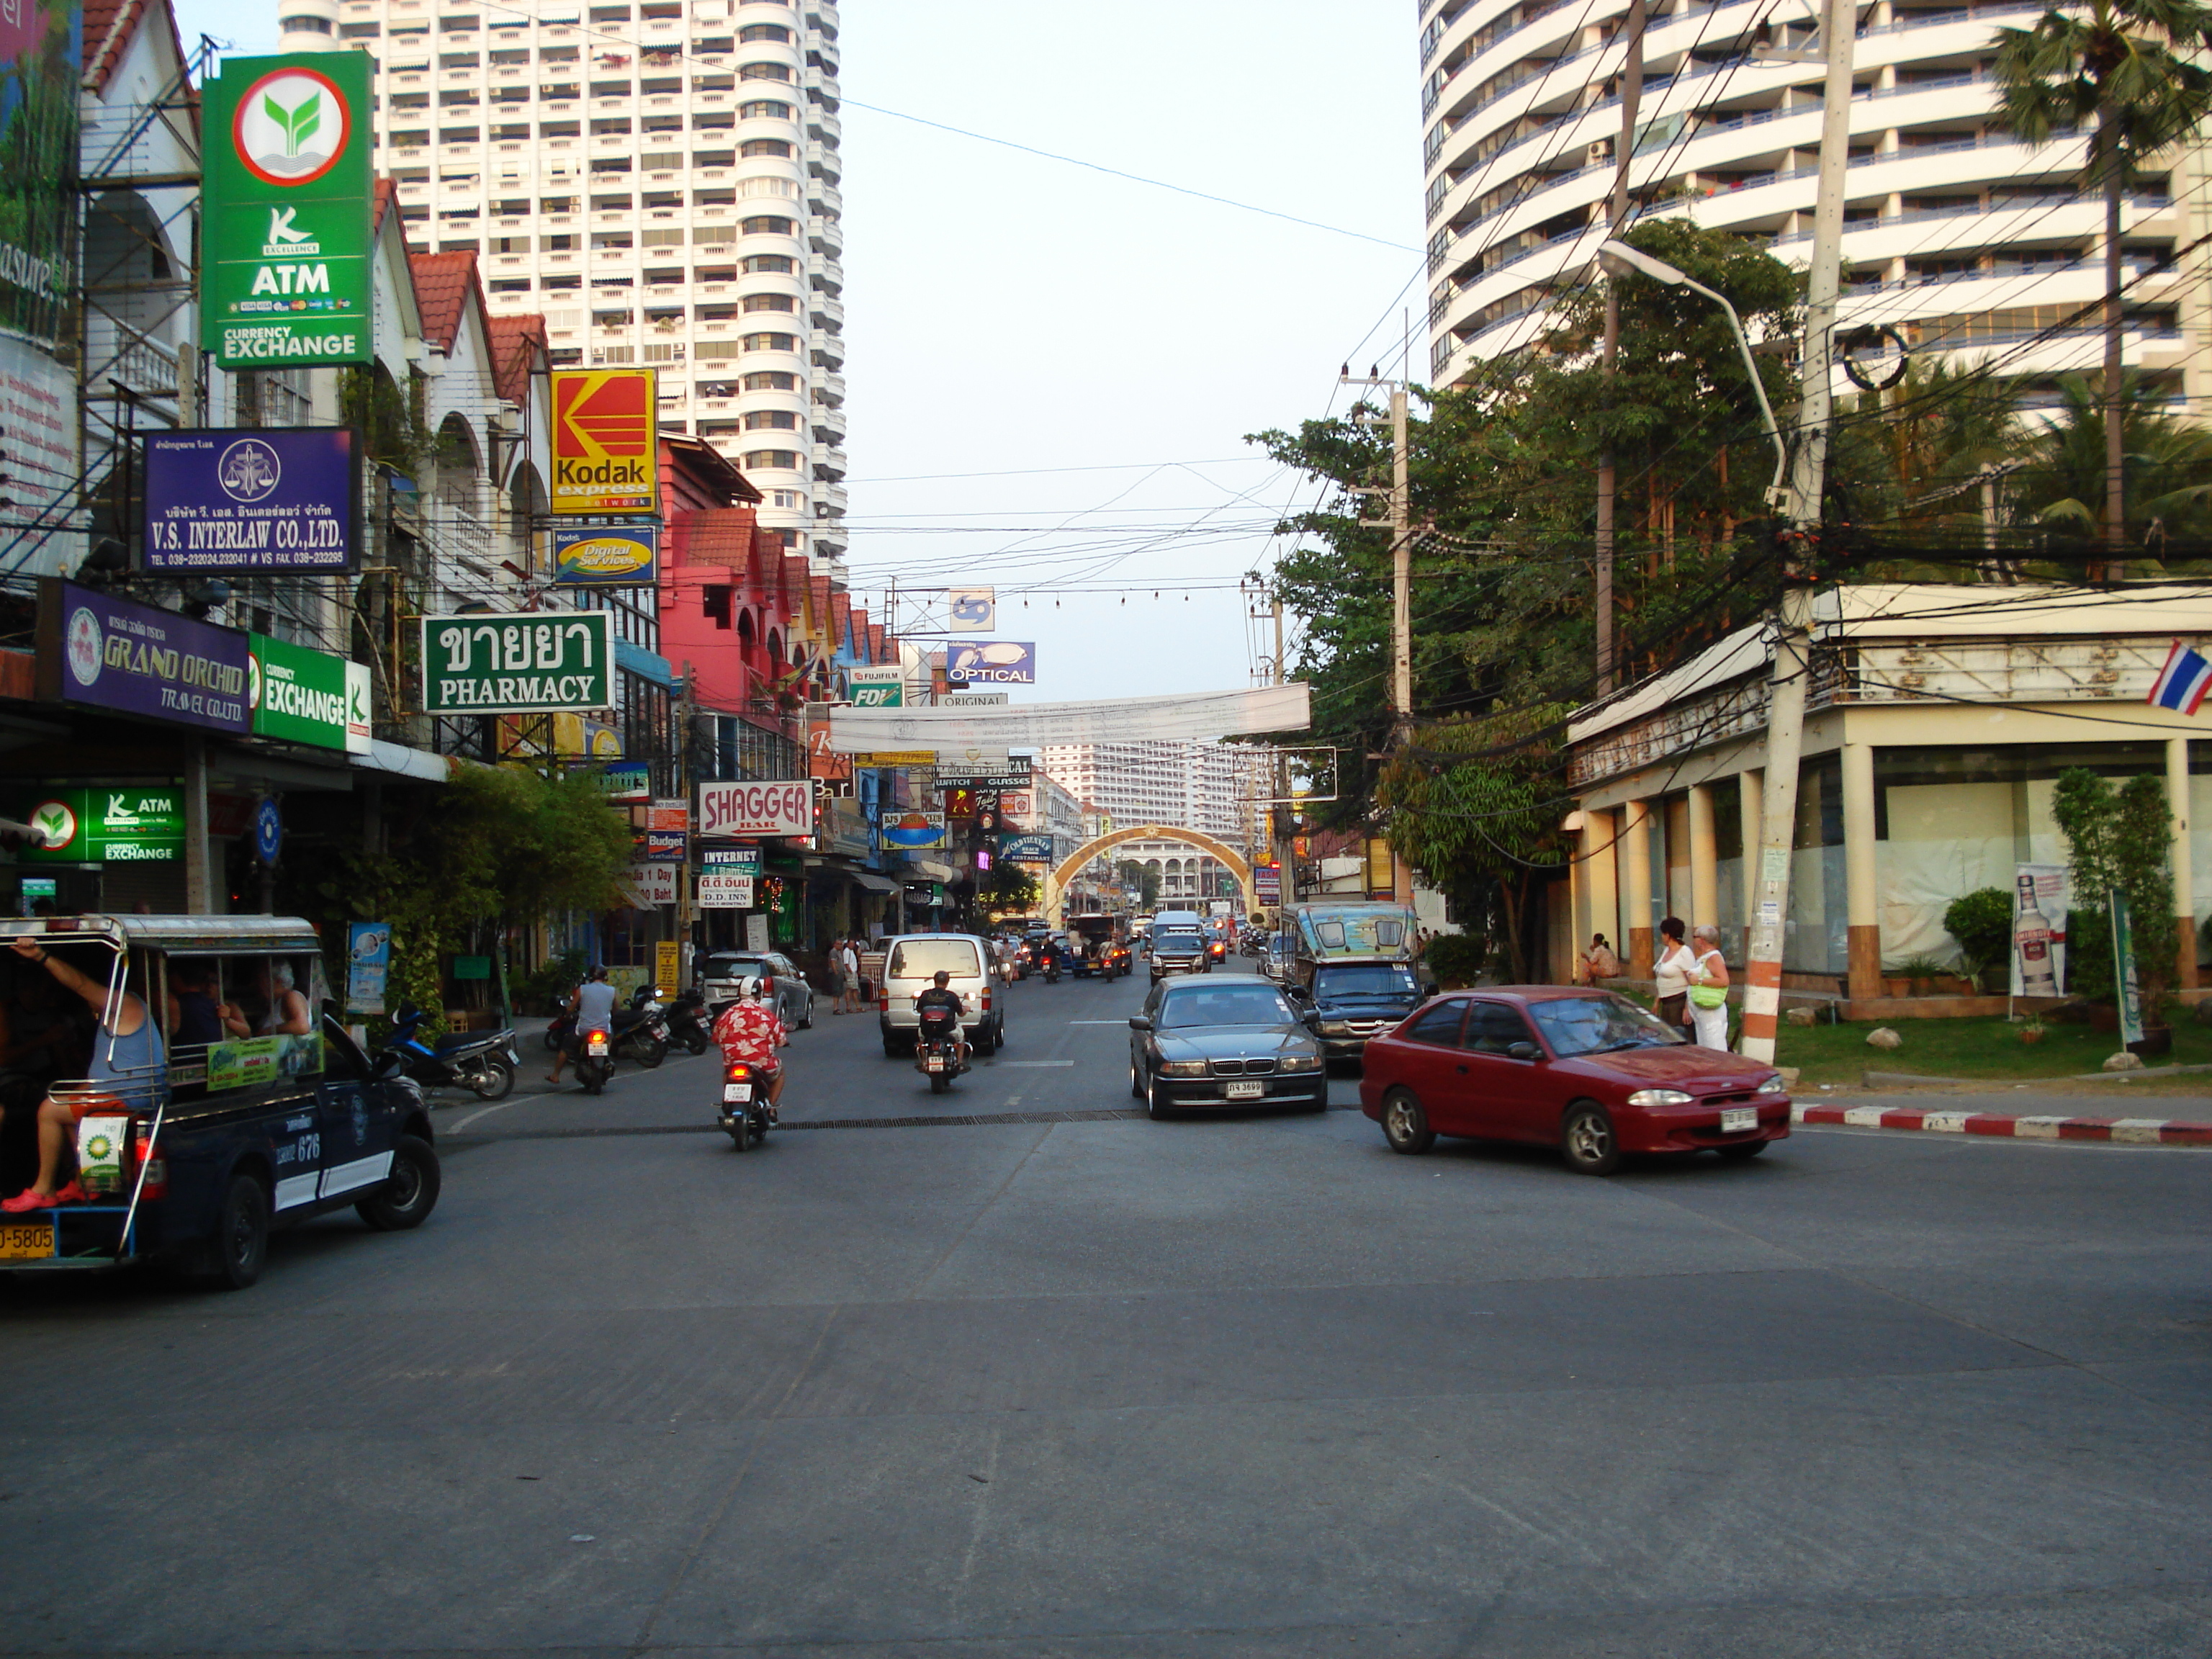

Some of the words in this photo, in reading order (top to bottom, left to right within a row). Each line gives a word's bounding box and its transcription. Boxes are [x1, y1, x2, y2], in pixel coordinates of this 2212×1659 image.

[266, 246, 317, 254] EXCELLENCE
[251, 264, 331, 296] ATM
[224, 327, 291, 339] CURRENCY
[225, 334, 356, 359] EXCHANGE
[557, 459, 645, 484] Kodak
[557, 484, 649, 497] express
[585, 498, 646, 506] network
[166, 505, 197, 518] บริษัท
[304, 504, 332, 516] จำกัด
[152, 521, 182, 549] V.S.
[188, 521, 271, 549] INTERLAW
[276, 519, 343, 550] CO.,LTD.
[557, 534, 580, 542] Kodak
[584, 544, 631, 557] Digital
[261, 552, 273, 565] VS
[294, 552, 343, 563] 038-232295
[578, 555, 636, 567] Services
[440, 623, 592, 672] ขายยา
[104, 634, 179, 681] GRAND
[182, 654, 244, 697] ORCHID
[266, 663, 295, 680] CURRENCY
[865, 672, 898, 680] FUJIFILM
[949, 669, 1033, 682] OPTICAL
[440, 675, 595, 705] PHARMACY
[161, 687, 204, 715] TRAVEL
[266, 678, 345, 727] EXCHANGE
[138, 799, 172, 812] ATM
[706, 787, 806, 830] SHAGGER
[884, 815, 899, 824] BJ'S
[900, 815, 923, 824] BEACH
[105, 849, 173, 860] EXCHANGE
[704, 850, 757, 863] INTERNET
[657, 868, 673, 883] Day
[655, 888, 672, 900] Baht
[905, 894, 931, 904] MASSAGE
[298, 1133, 320, 1161] 676
